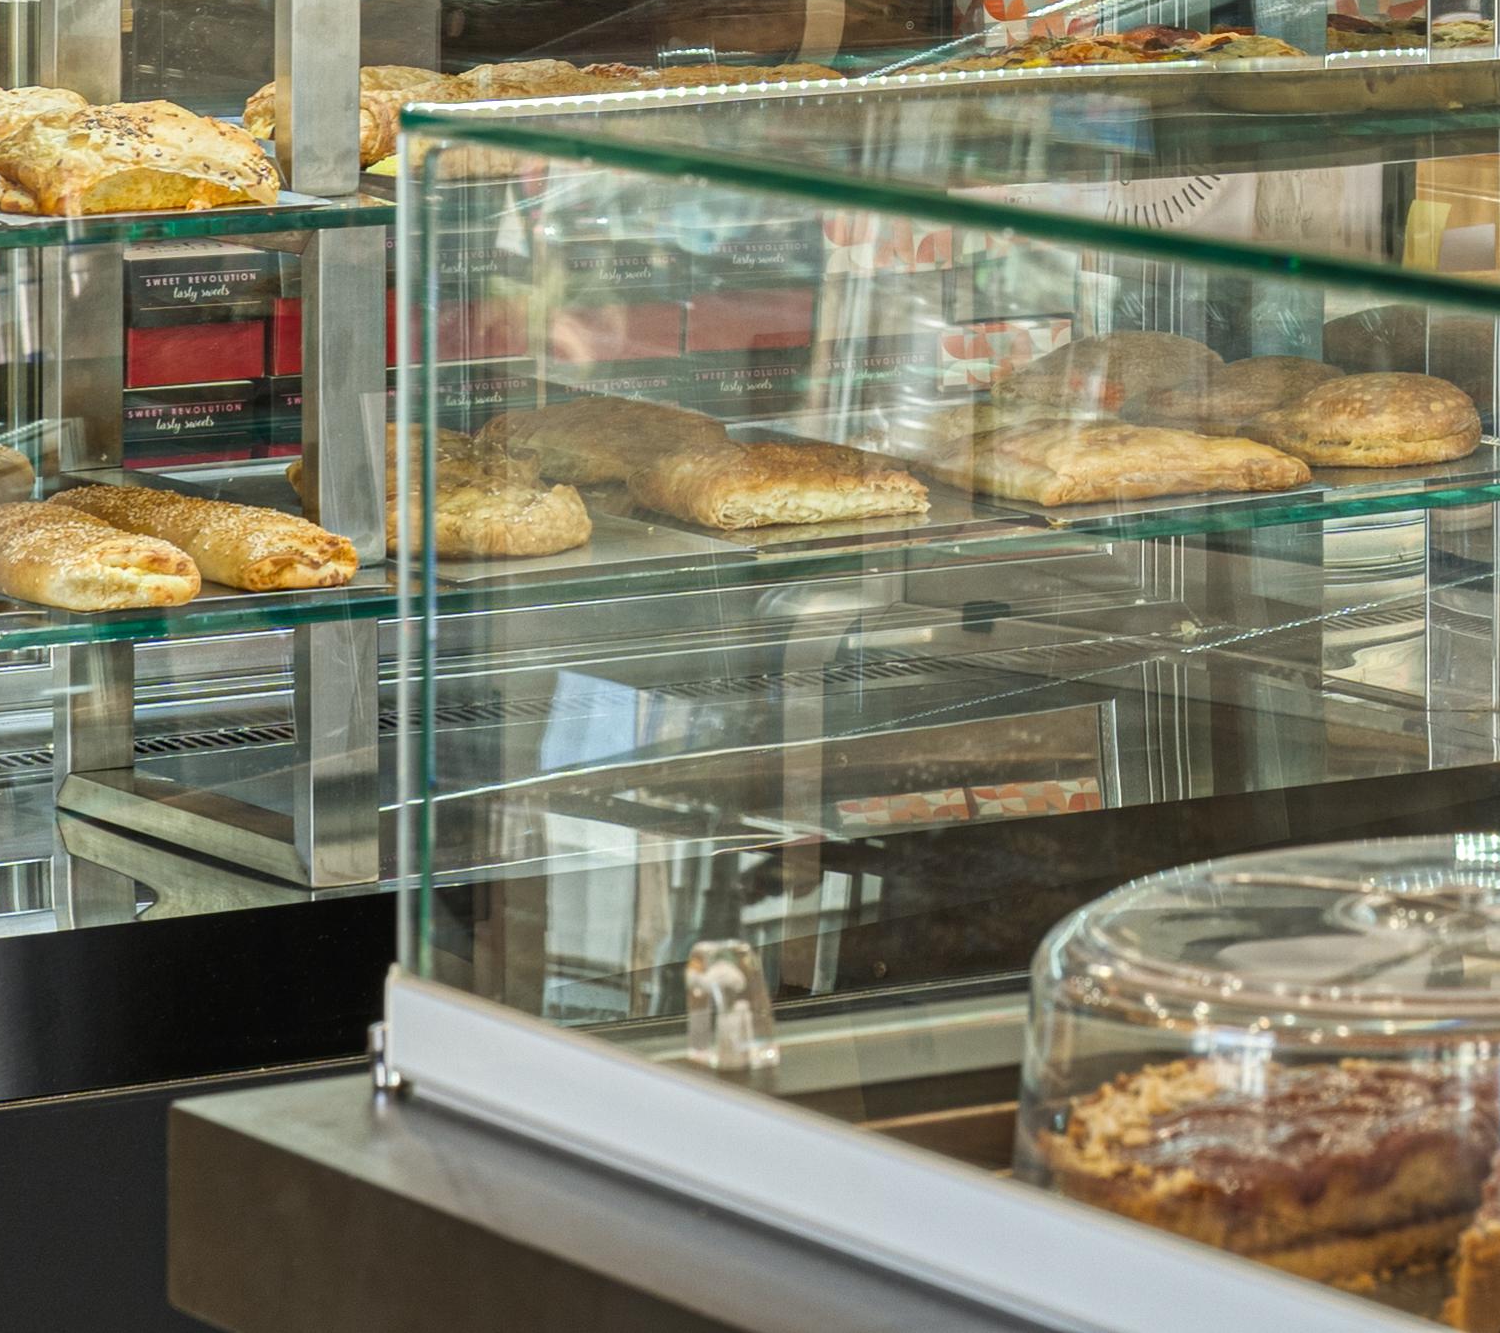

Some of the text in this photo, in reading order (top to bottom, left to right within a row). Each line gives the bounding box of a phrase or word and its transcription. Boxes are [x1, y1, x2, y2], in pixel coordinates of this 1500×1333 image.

[146, 273, 257, 287] SWEET REVOLUTION
[173, 284, 230, 302] tasty sweets
[128, 403, 242, 419] SWEET REVOLUTION
[156, 416, 215, 434] tasty sweets
